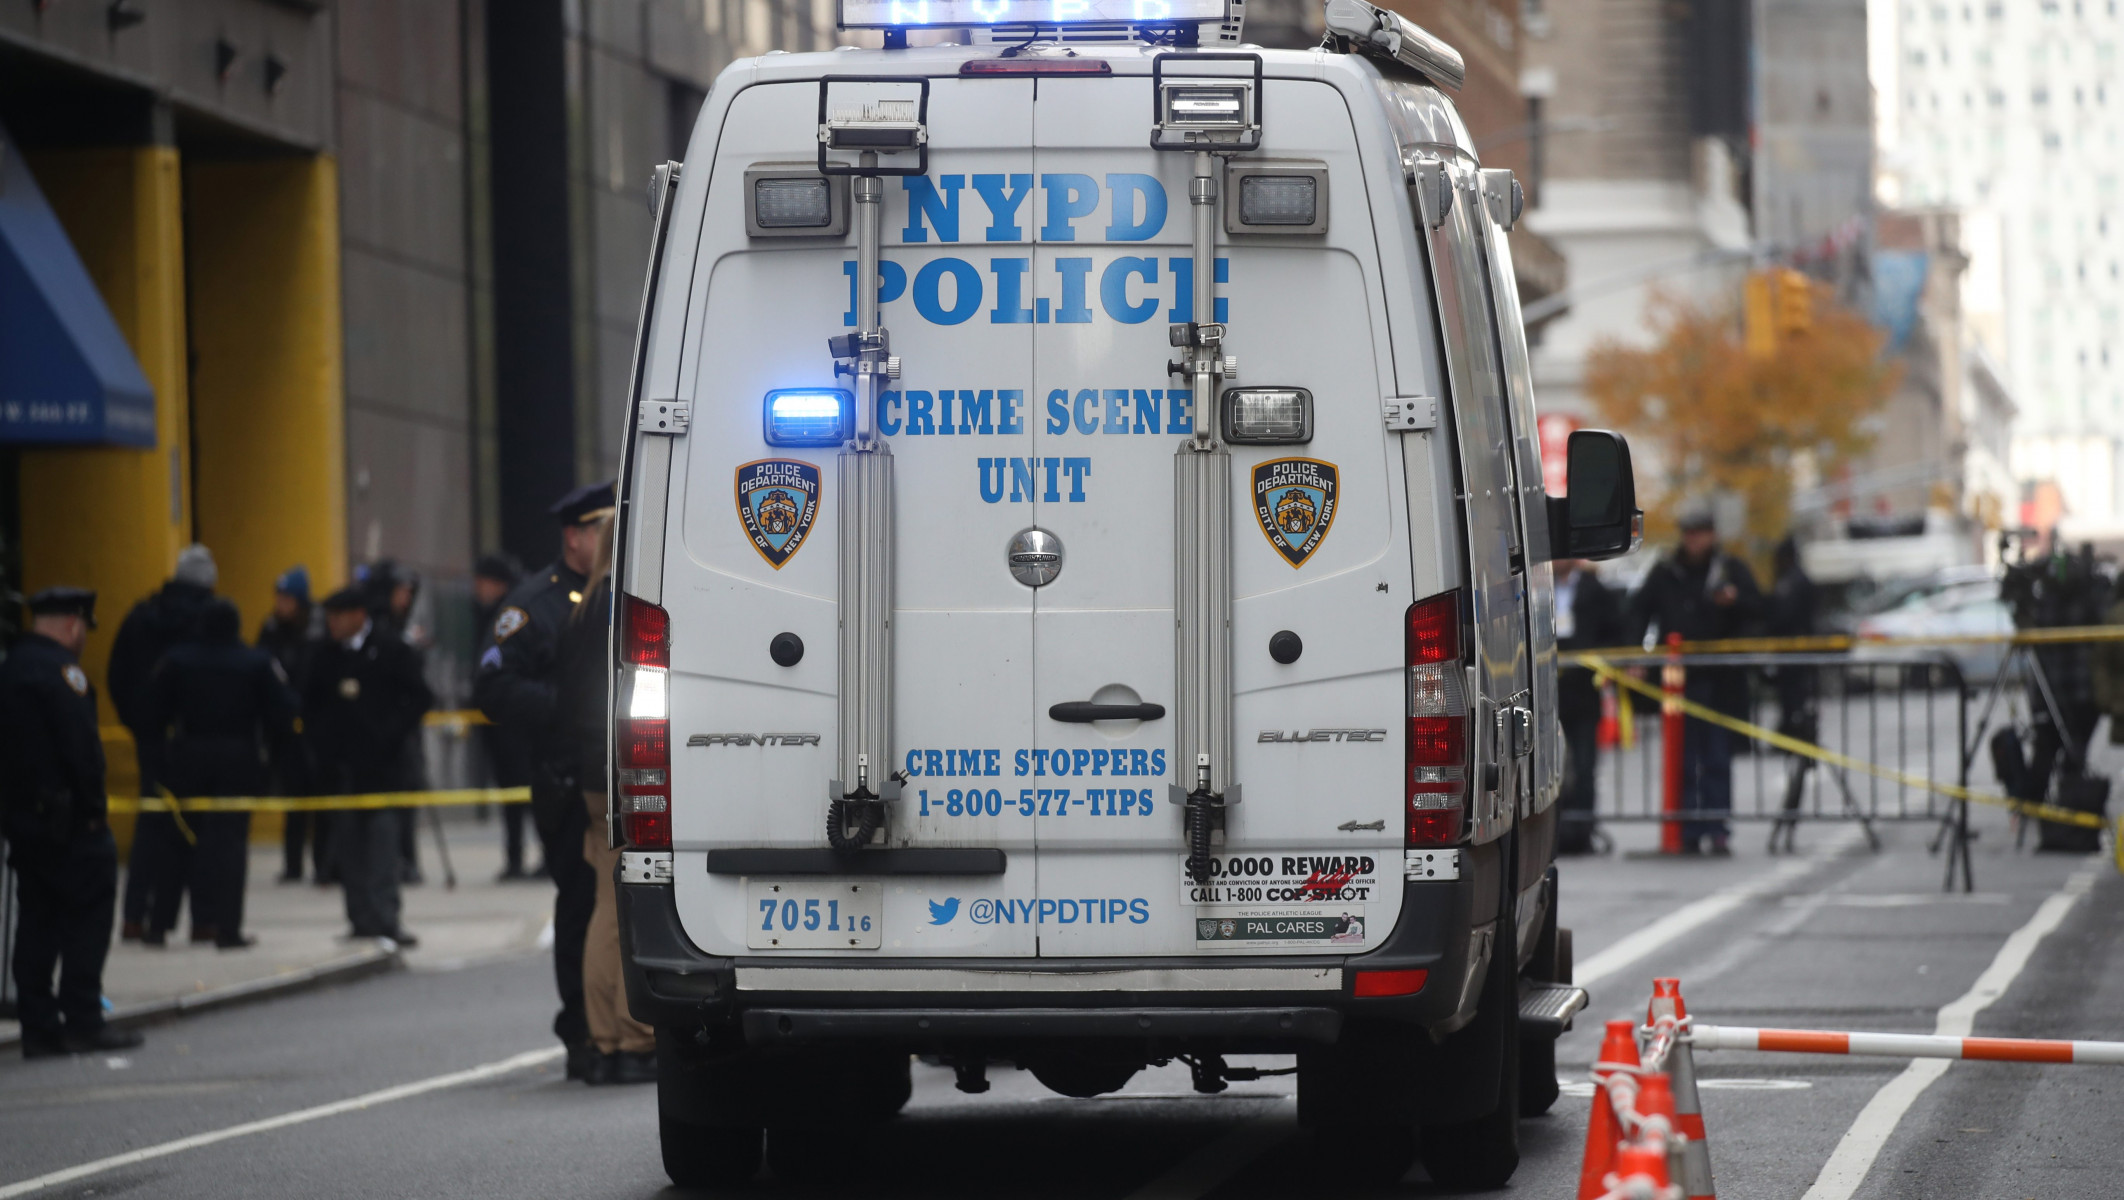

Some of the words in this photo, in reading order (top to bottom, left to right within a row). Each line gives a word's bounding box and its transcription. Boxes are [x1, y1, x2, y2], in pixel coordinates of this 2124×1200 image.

[902, 173, 1169, 243] NYPD
[843, 257, 1229, 326] POLICE
[876, 389, 1024, 436] CRIME
[1047, 388, 1193, 435] SCENE
[757, 464, 801, 477] POLICE
[977, 456, 1091, 503] UNIT
[1257, 473, 1333, 494] DEPARTMENT
[1273, 463, 1318, 476] POLICE
[741, 474, 816, 494] DEPARTMENT
[742, 506, 758, 532] CITY
[755, 535, 768, 548] OF
[784, 532, 802, 554] NEW
[800, 500, 816, 527] YORK
[1259, 506, 1275, 531] CITY
[1273, 535, 1287, 548] OF
[1303, 531, 1321, 553] NEW
[1319, 499, 1334, 527] YORK
[686, 733, 821, 747] SPRINTER
[1257, 728, 1387, 743] BLUETEC
[905, 749, 1001, 777] CRIME
[1014, 748, 1166, 777] STOPPERS
[918, 789, 1153, 817] 1-800-577-TIPS
[1185, 856, 1274, 879] $0,000
[1281, 856, 1375, 876] REWARD
[1190, 888, 1222, 902] CALL
[1226, 887, 1262, 902] 1-800
[1266, 886, 1370, 902] COP-SHOT
[759, 898, 840, 932] 7051
[847, 915, 872, 932] 16
[969, 897, 1150, 925] @NYPDTIPS
[1247, 922, 1273, 934] PAL
[1276, 921, 1325, 934] CARES
